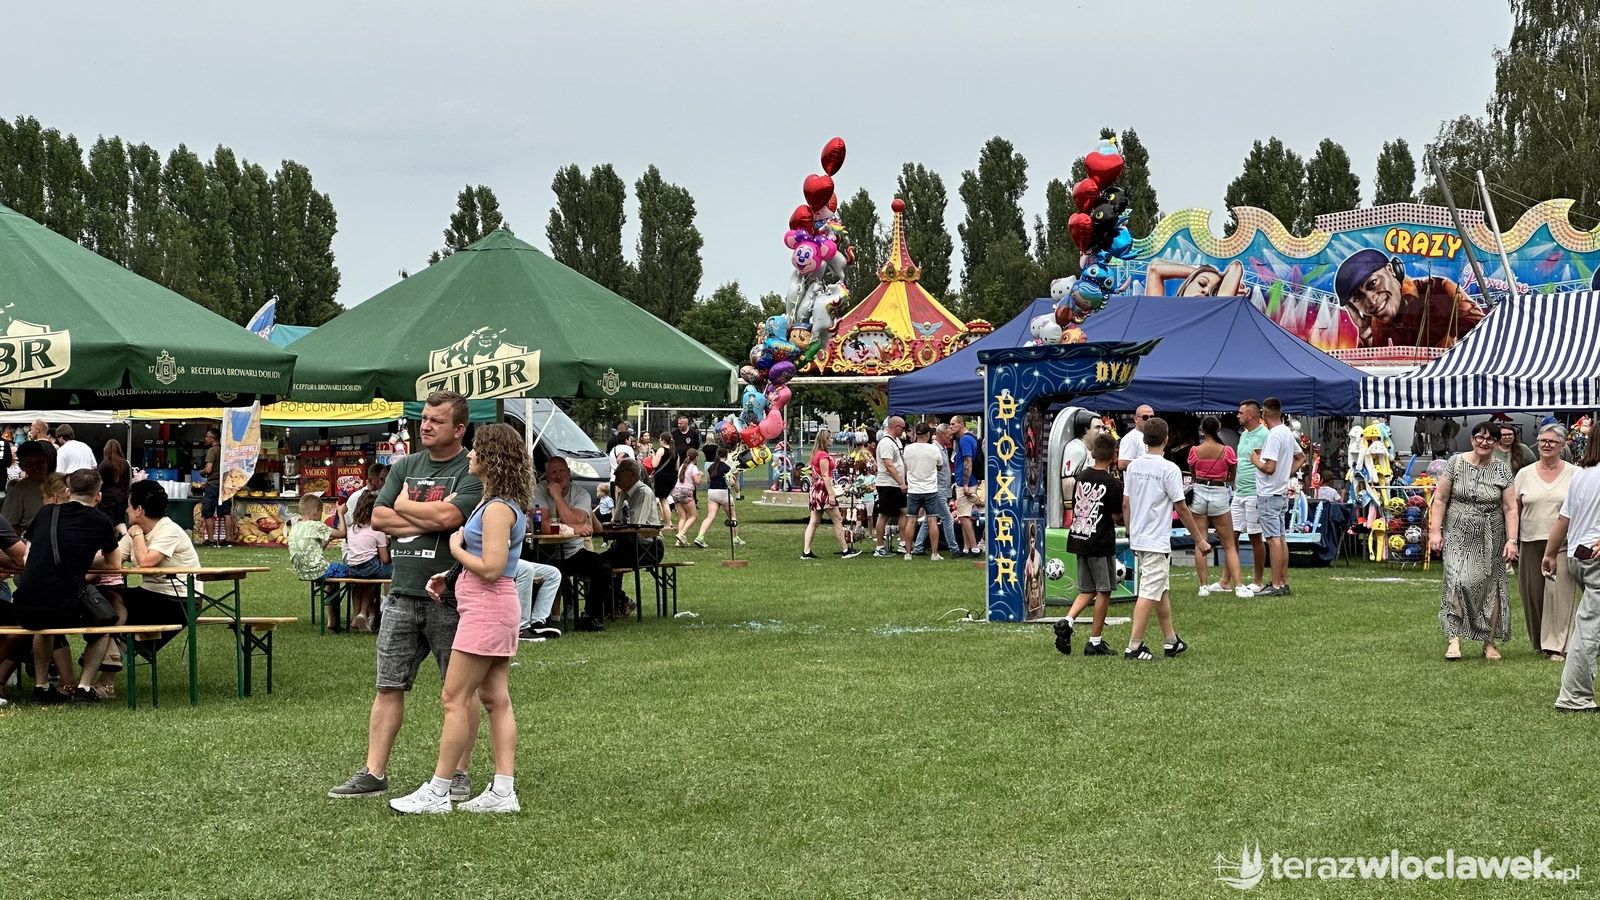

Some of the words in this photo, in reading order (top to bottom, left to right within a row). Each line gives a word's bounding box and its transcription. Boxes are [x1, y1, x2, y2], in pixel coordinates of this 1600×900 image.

[1384, 227, 1463, 260] CRAZY
[0, 338, 56, 377] BR
[177, 366, 185, 374] 68
[191, 366, 226, 376] RECEPTURA
[227, 368, 258, 377] BROWARU
[1095, 361, 1132, 384] DYN
[632, 381, 662, 389] RECEPTURA
[281, 401, 336, 412] POPCORN
[340, 401, 395, 412] NACHOSY
[338, 467, 362, 475] POPCORN
[1065, 460, 1072, 471] 1
[993, 390, 1020, 590] BOXER
